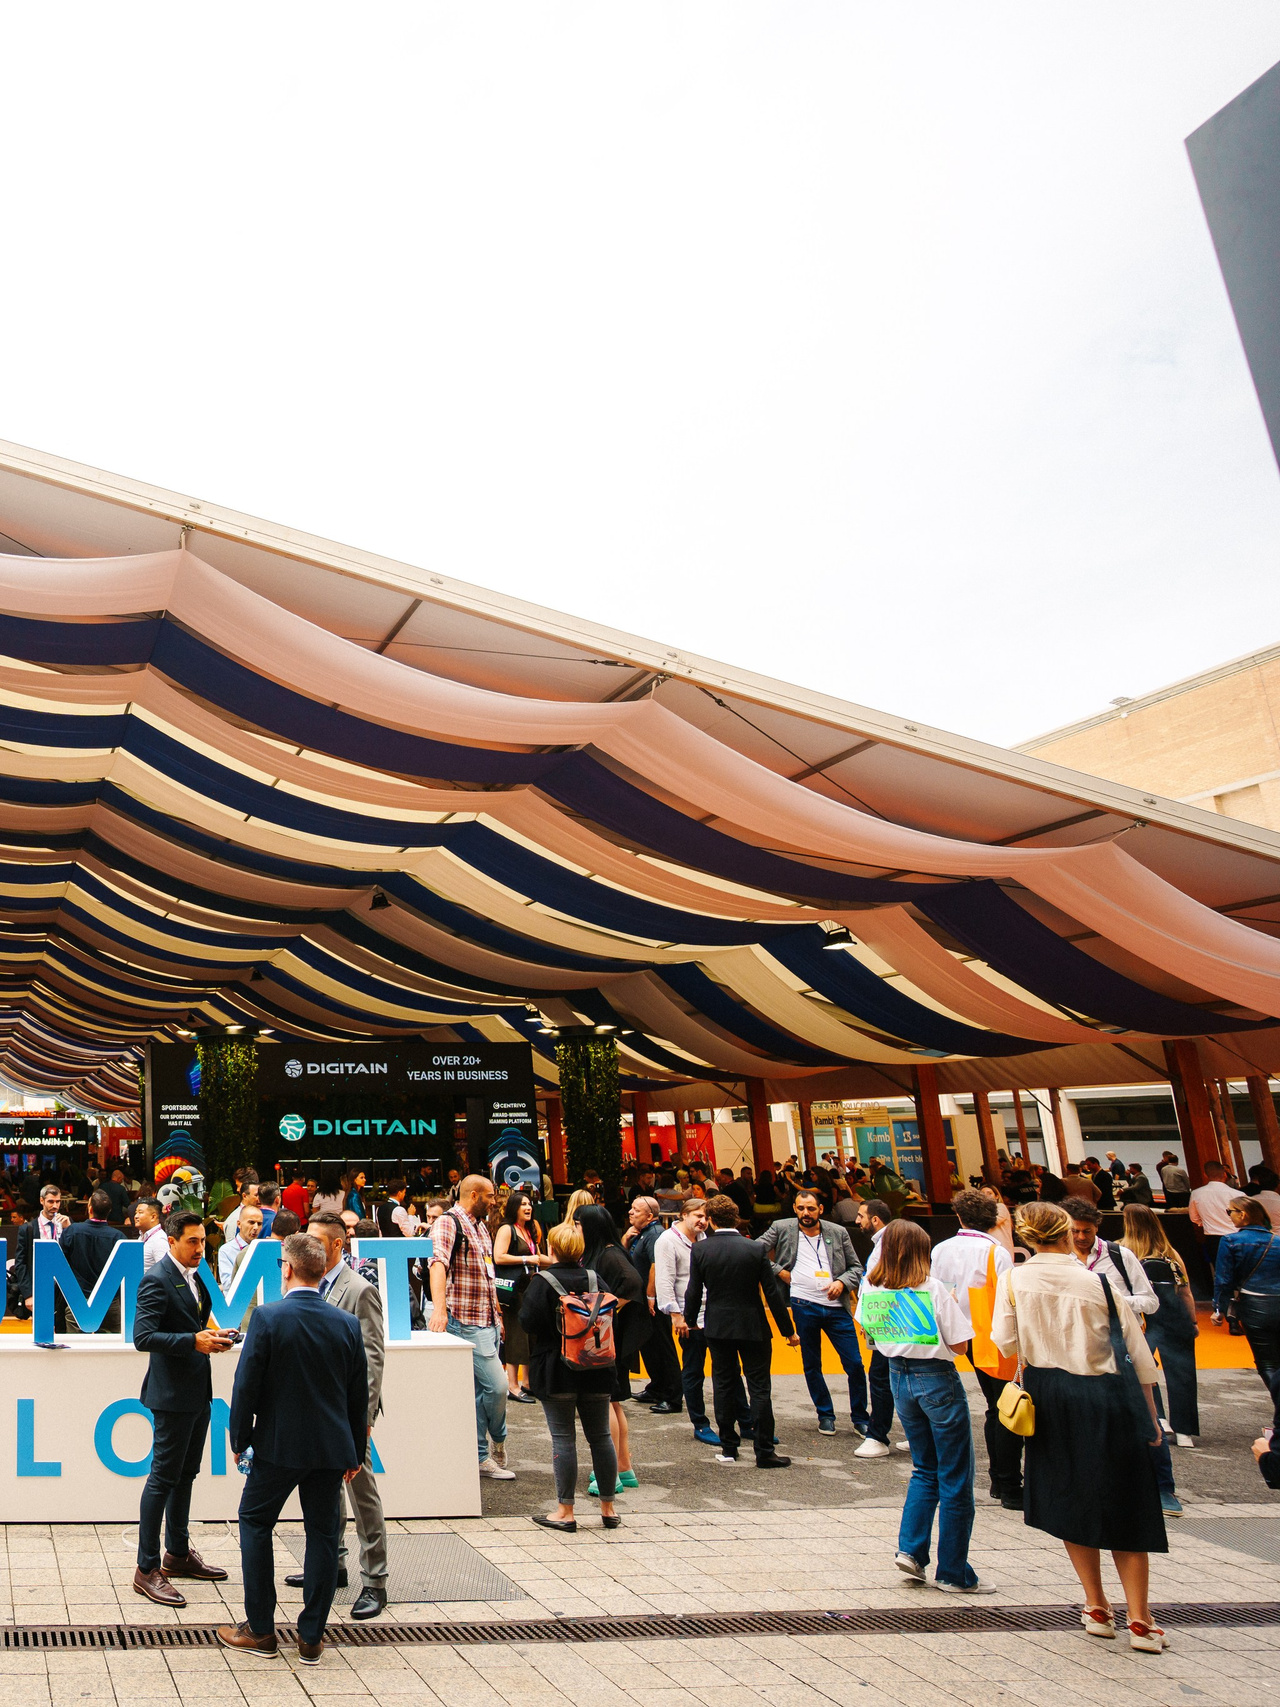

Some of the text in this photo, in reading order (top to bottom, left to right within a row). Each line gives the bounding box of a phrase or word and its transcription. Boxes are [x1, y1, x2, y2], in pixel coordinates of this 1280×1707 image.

[432, 1055, 482, 1066] OVER 20+
[306, 1062, 388, 1075] DIGITAIN
[406, 1070, 509, 1081] YEARS IN BUSINESS
[814, 1115, 835, 1126] Kambi
[313, 1119, 437, 1136] DIGITAIN
[21, 1137, 41, 1146] AND
[867, 1131, 890, 1143] Kamb
[495, 1277, 515, 1287] EBET
[867, 1300, 900, 1310] GROW
[866, 1313, 891, 1323] WIN
[868, 1326, 909, 1336] REPEAT
